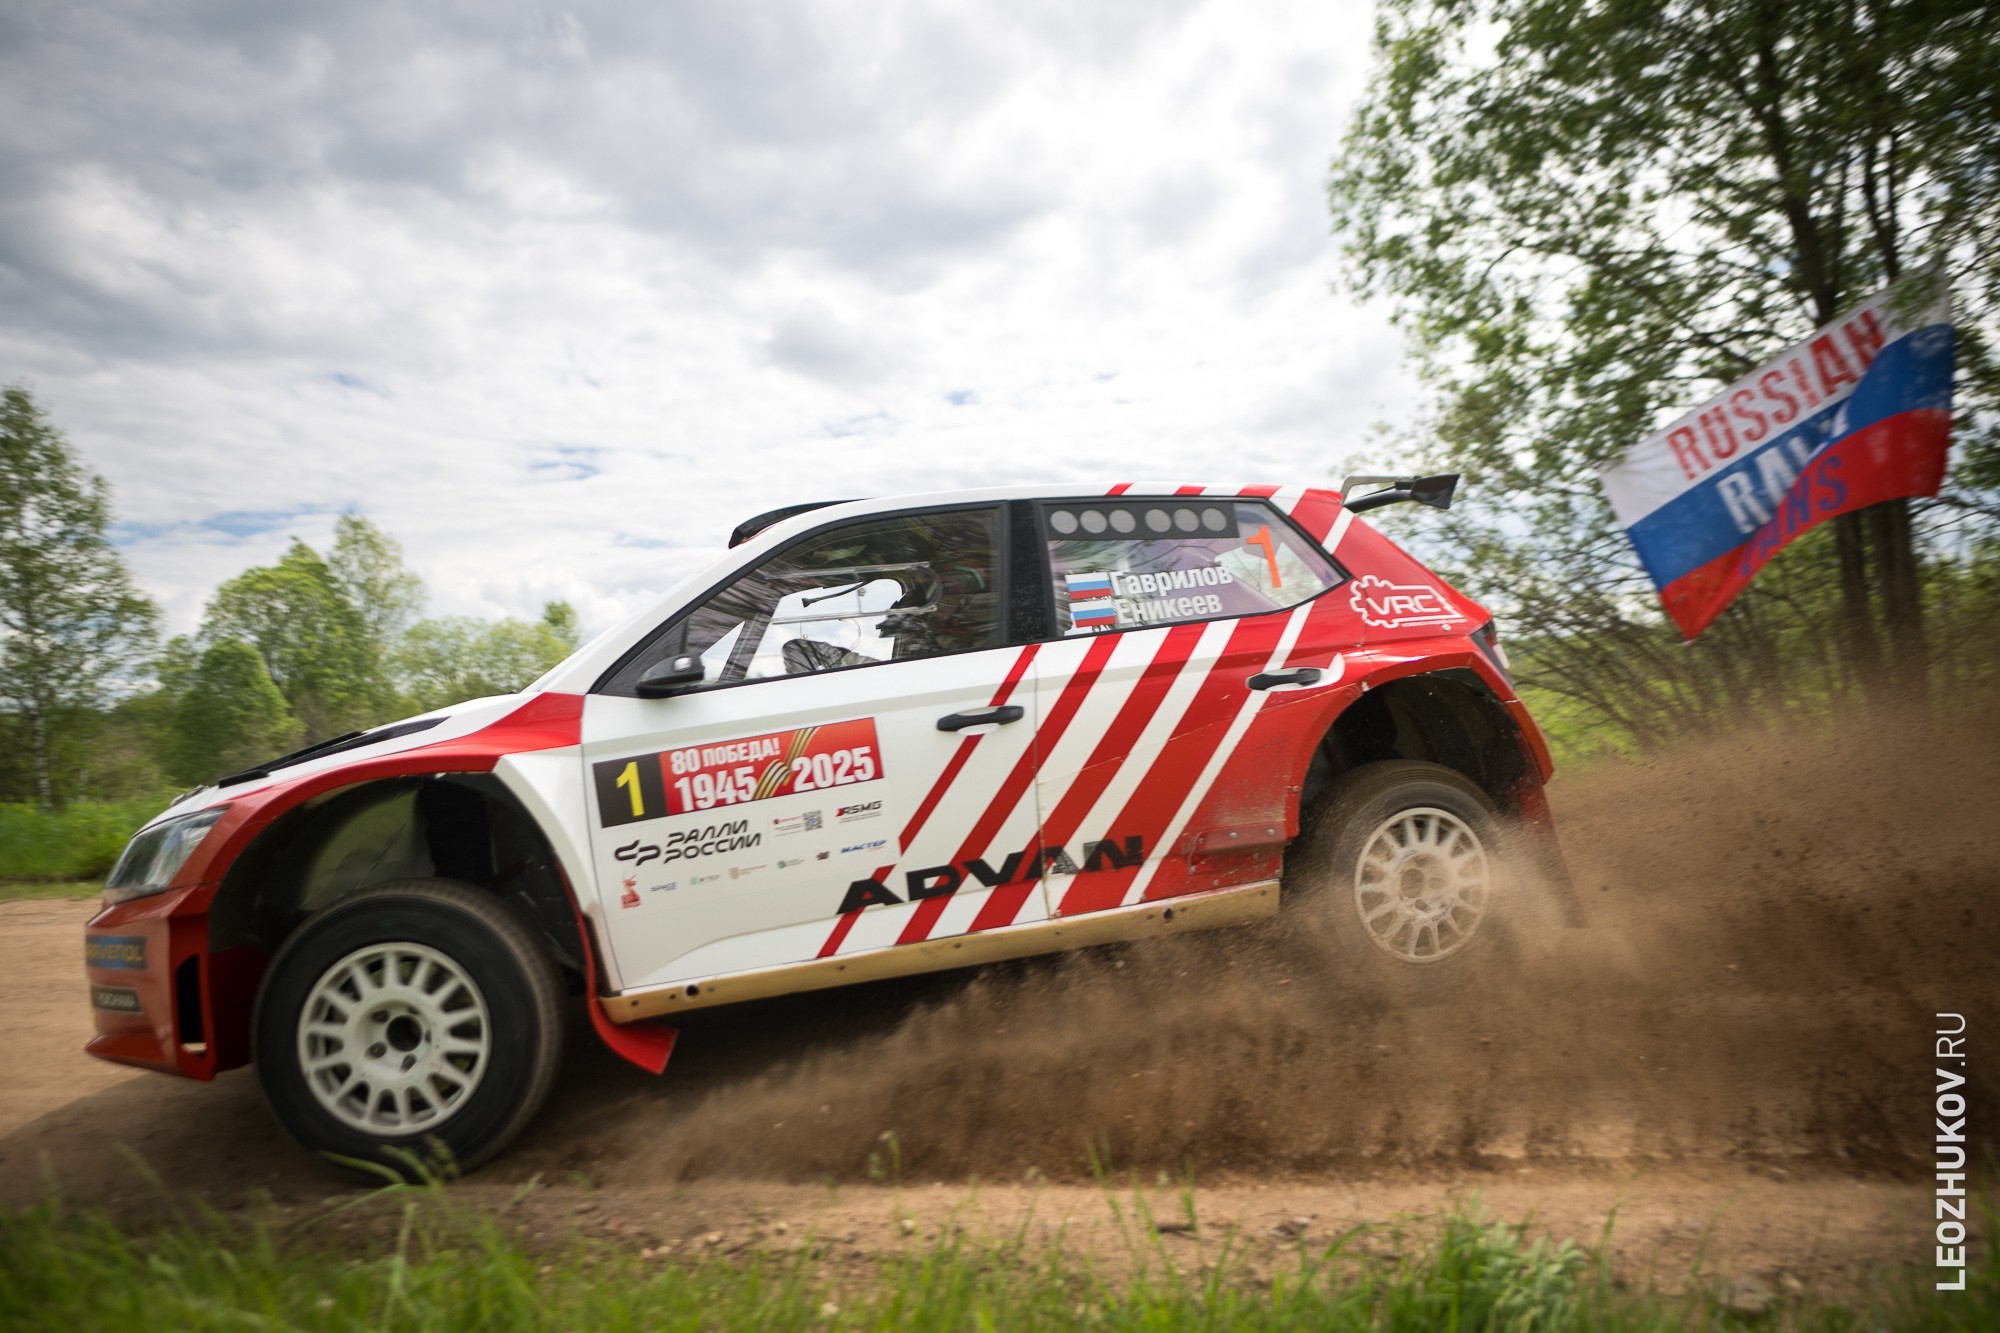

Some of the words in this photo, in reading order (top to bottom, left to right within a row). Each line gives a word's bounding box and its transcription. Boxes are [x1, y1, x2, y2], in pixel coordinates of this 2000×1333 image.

[1665, 309, 1886, 481] RUSSIAN
[1247, 525, 1282, 588] 1
[1109, 565, 1234, 597] Гаврилов
[1114, 594, 1223, 624] Еникеев
[1365, 594, 1442, 615] VRC
[670, 749, 700, 775] 80
[703, 737, 780, 767] ПОБЕДА!
[616, 761, 645, 817] 1
[674, 765, 757, 812] 1945
[792, 745, 875, 793] 2025
[664, 832, 762, 864] РОССИИ
[667, 818, 748, 847] РАЛЛИ
[836, 835, 1145, 915] ADVAN
